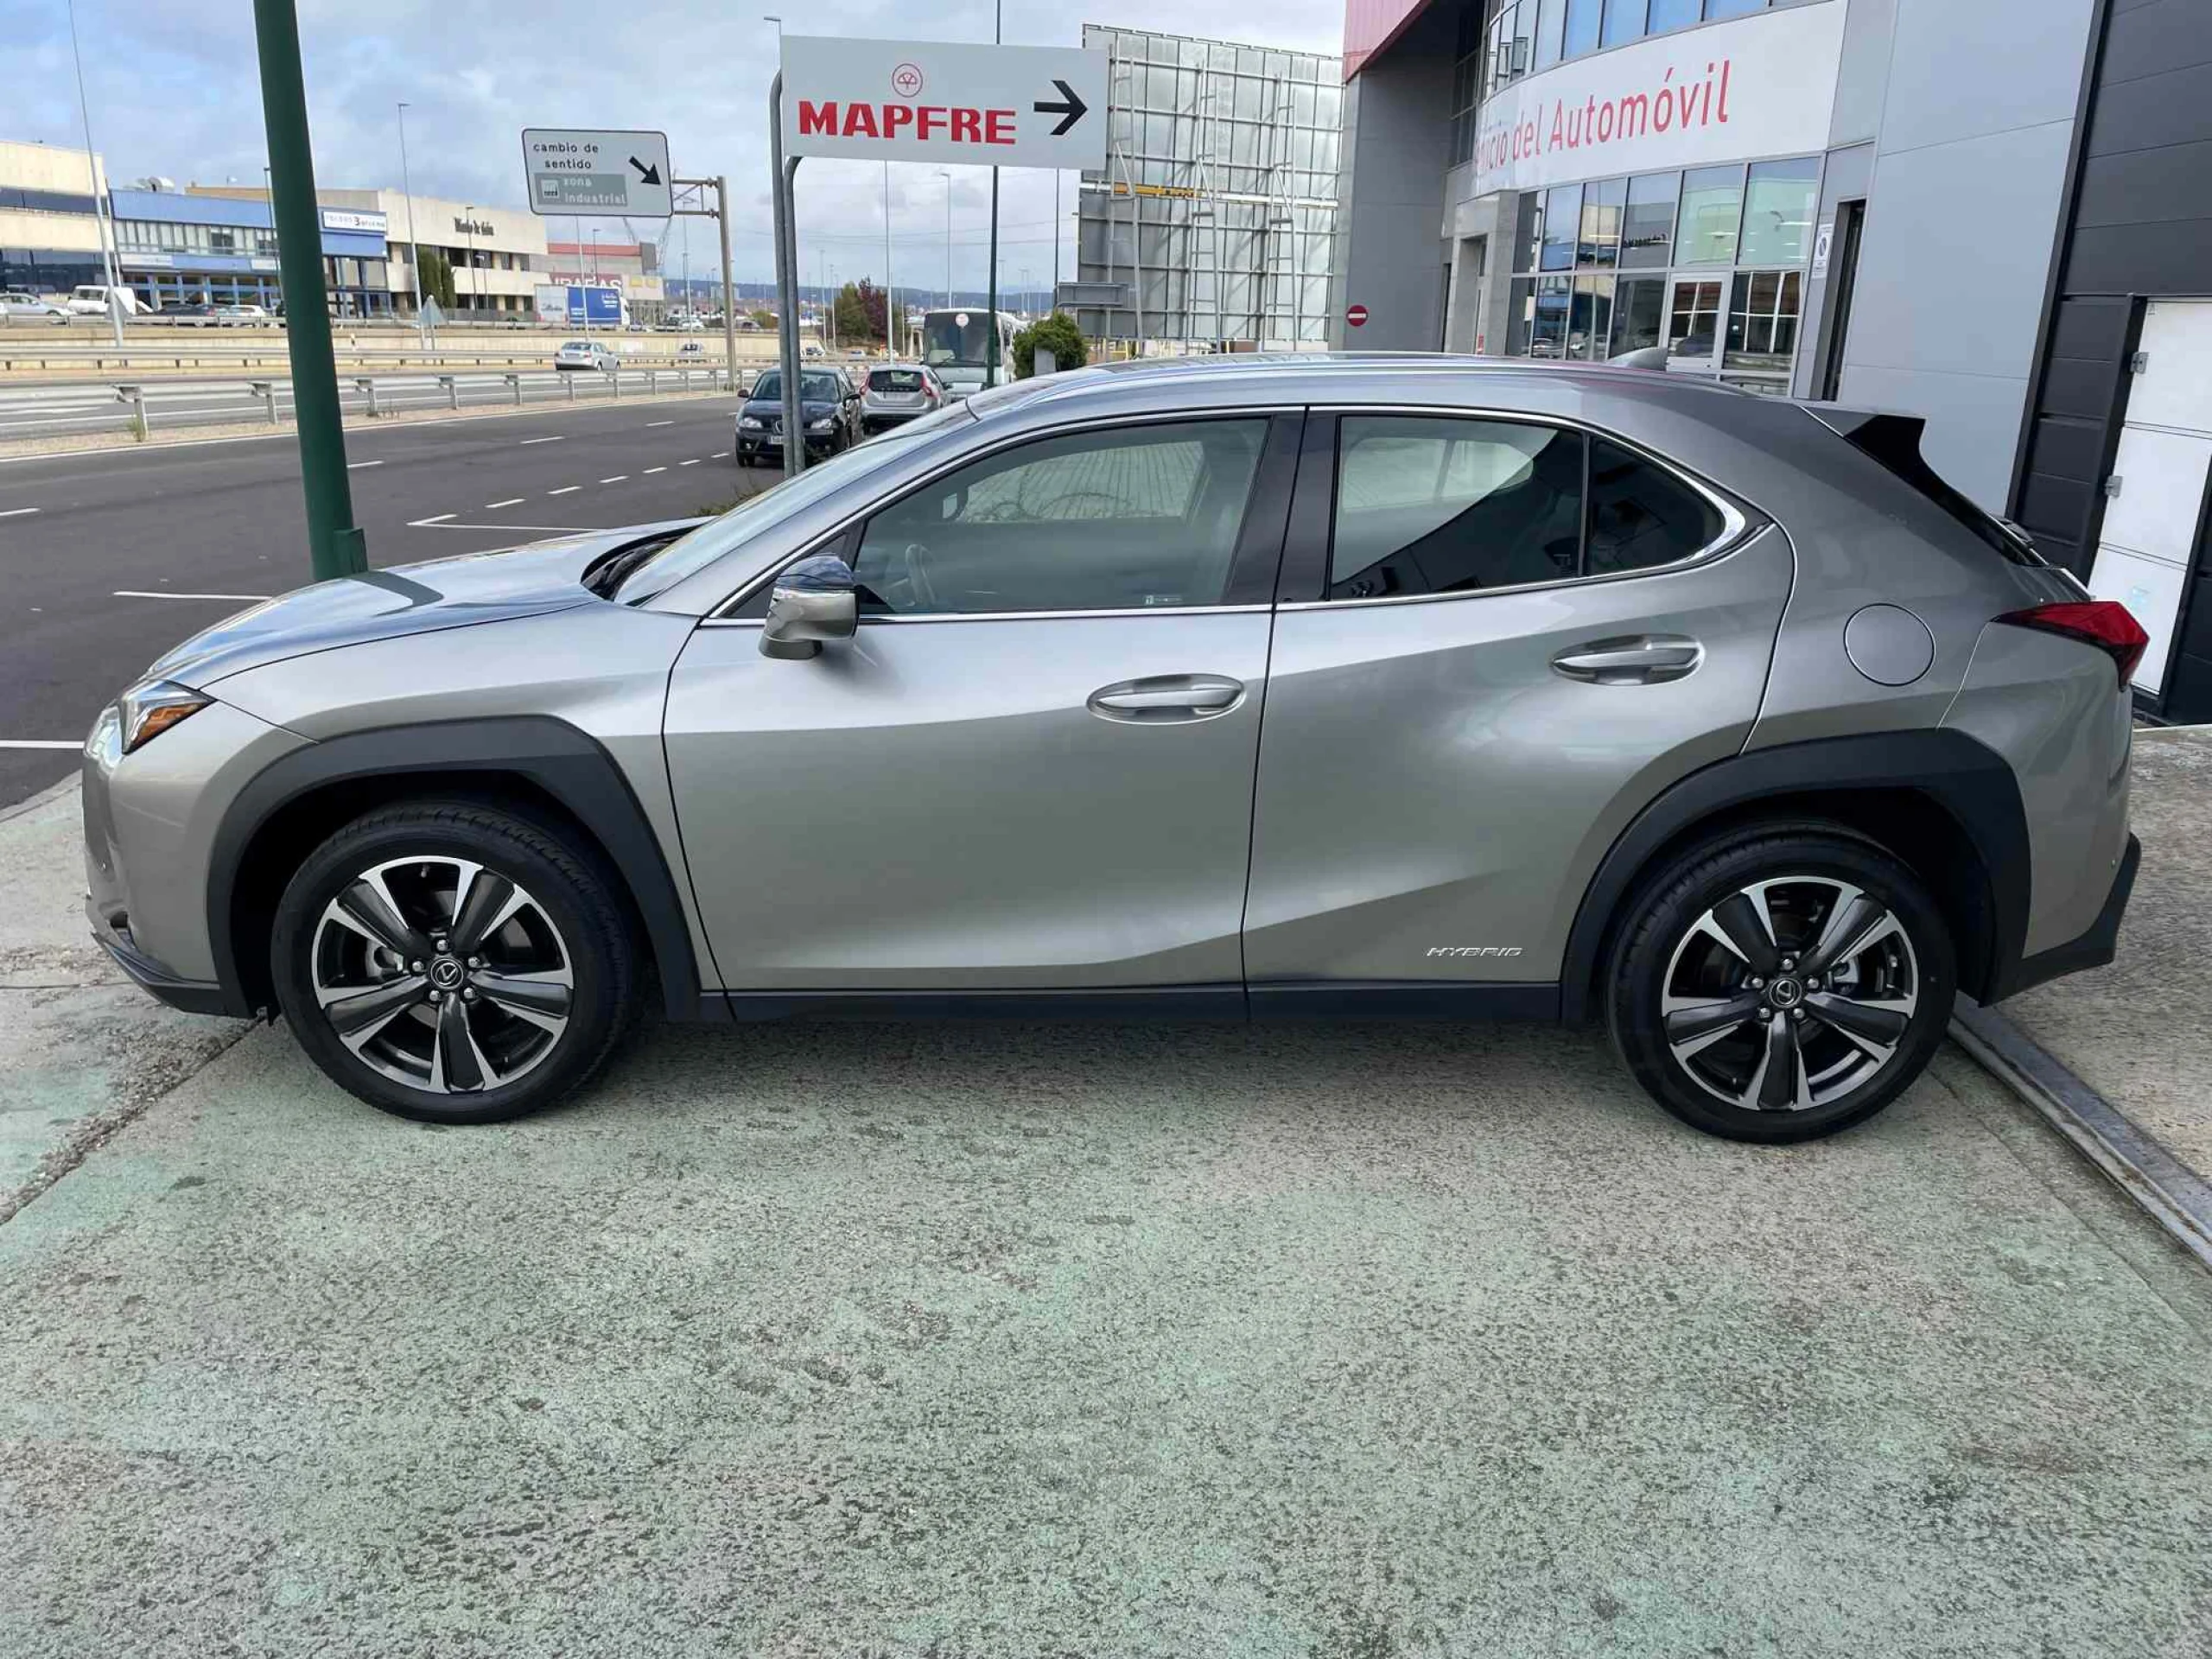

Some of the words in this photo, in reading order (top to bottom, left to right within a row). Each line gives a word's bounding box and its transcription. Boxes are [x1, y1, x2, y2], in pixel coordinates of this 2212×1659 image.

[1513, 103, 1543, 162] del
[1548, 59, 1731, 153] Automóvil
[798, 99, 1016, 145] MAPFRE
[532, 141, 578, 153] cambio
[584, 143, 599, 153] de
[544, 158, 592, 168] sentido
[563, 177, 592, 188] zona
[564, 192, 626, 205] industrial
[1427, 947, 1522, 957] HYBRID
